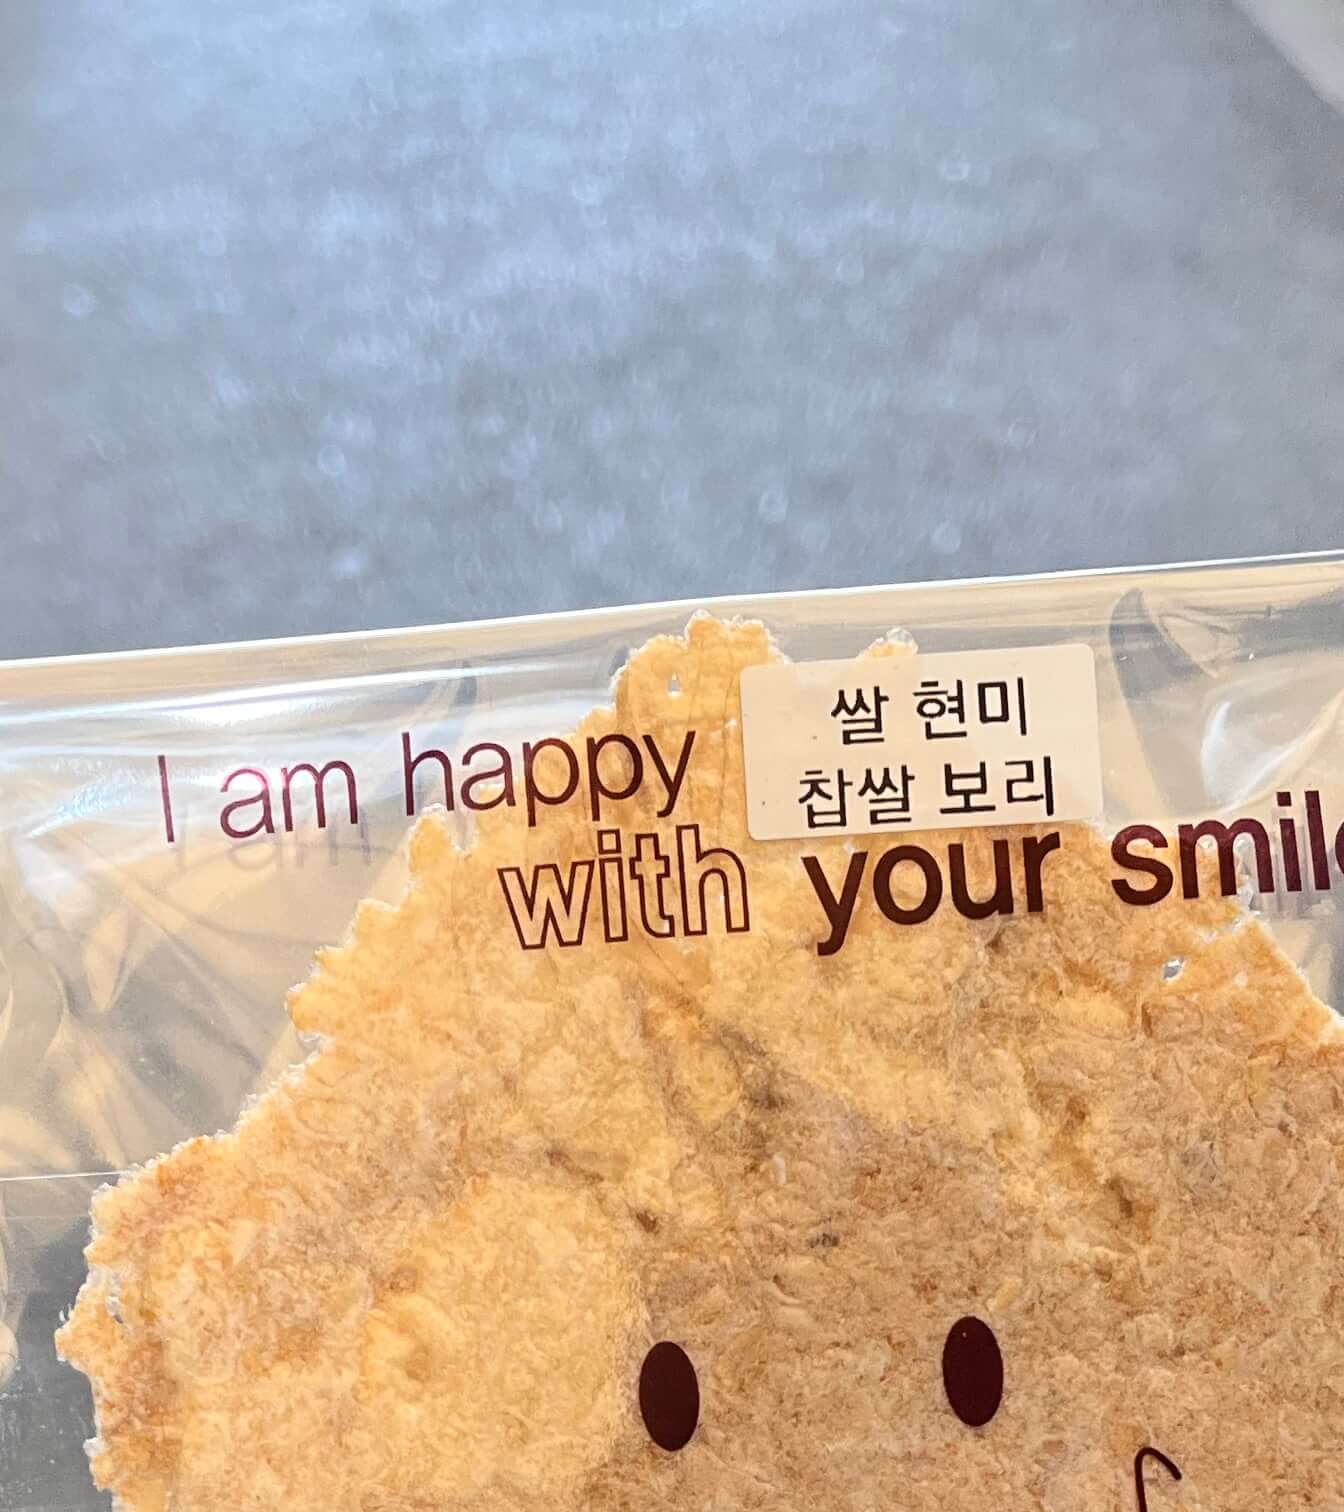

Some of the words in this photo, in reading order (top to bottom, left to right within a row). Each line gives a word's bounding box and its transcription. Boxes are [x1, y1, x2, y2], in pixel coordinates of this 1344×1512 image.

[831, 686, 889, 745] 쌀
[913, 677, 1027, 740] 현미
[157, 754, 175, 843] I
[219, 760, 359, 839] am
[401, 731, 696, 827] happy
[798, 764, 915, 829] 찹쌀
[940, 756, 1054, 817] 보리
[497, 824, 750, 950] with
[801, 830, 1061, 957] your
